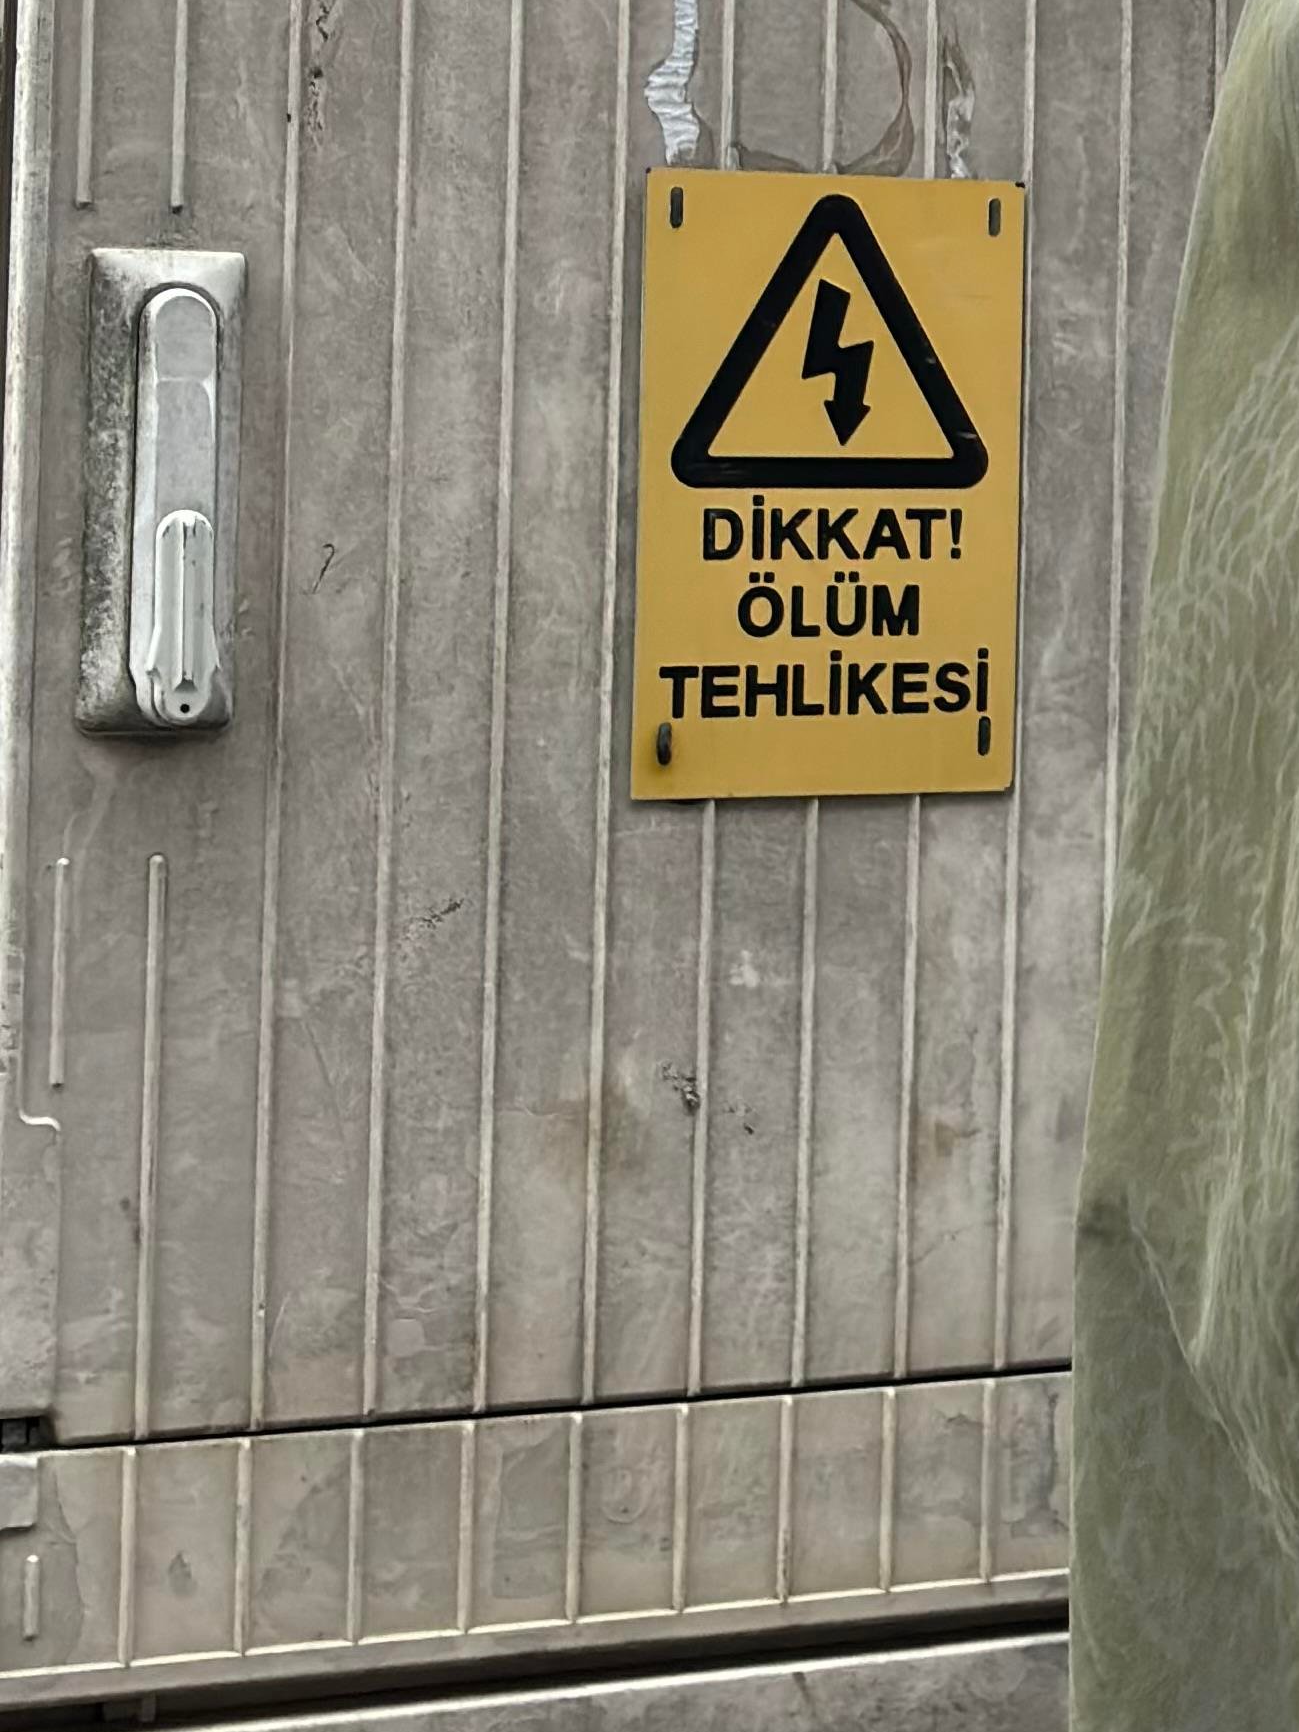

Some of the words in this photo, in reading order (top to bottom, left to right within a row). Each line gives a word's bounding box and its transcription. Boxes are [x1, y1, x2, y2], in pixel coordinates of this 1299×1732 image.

[702, 495, 963, 562] DİKKAT!
[737, 571, 920, 638] ÖLÜM
[659, 648, 989, 720] TEHLİKESİ
